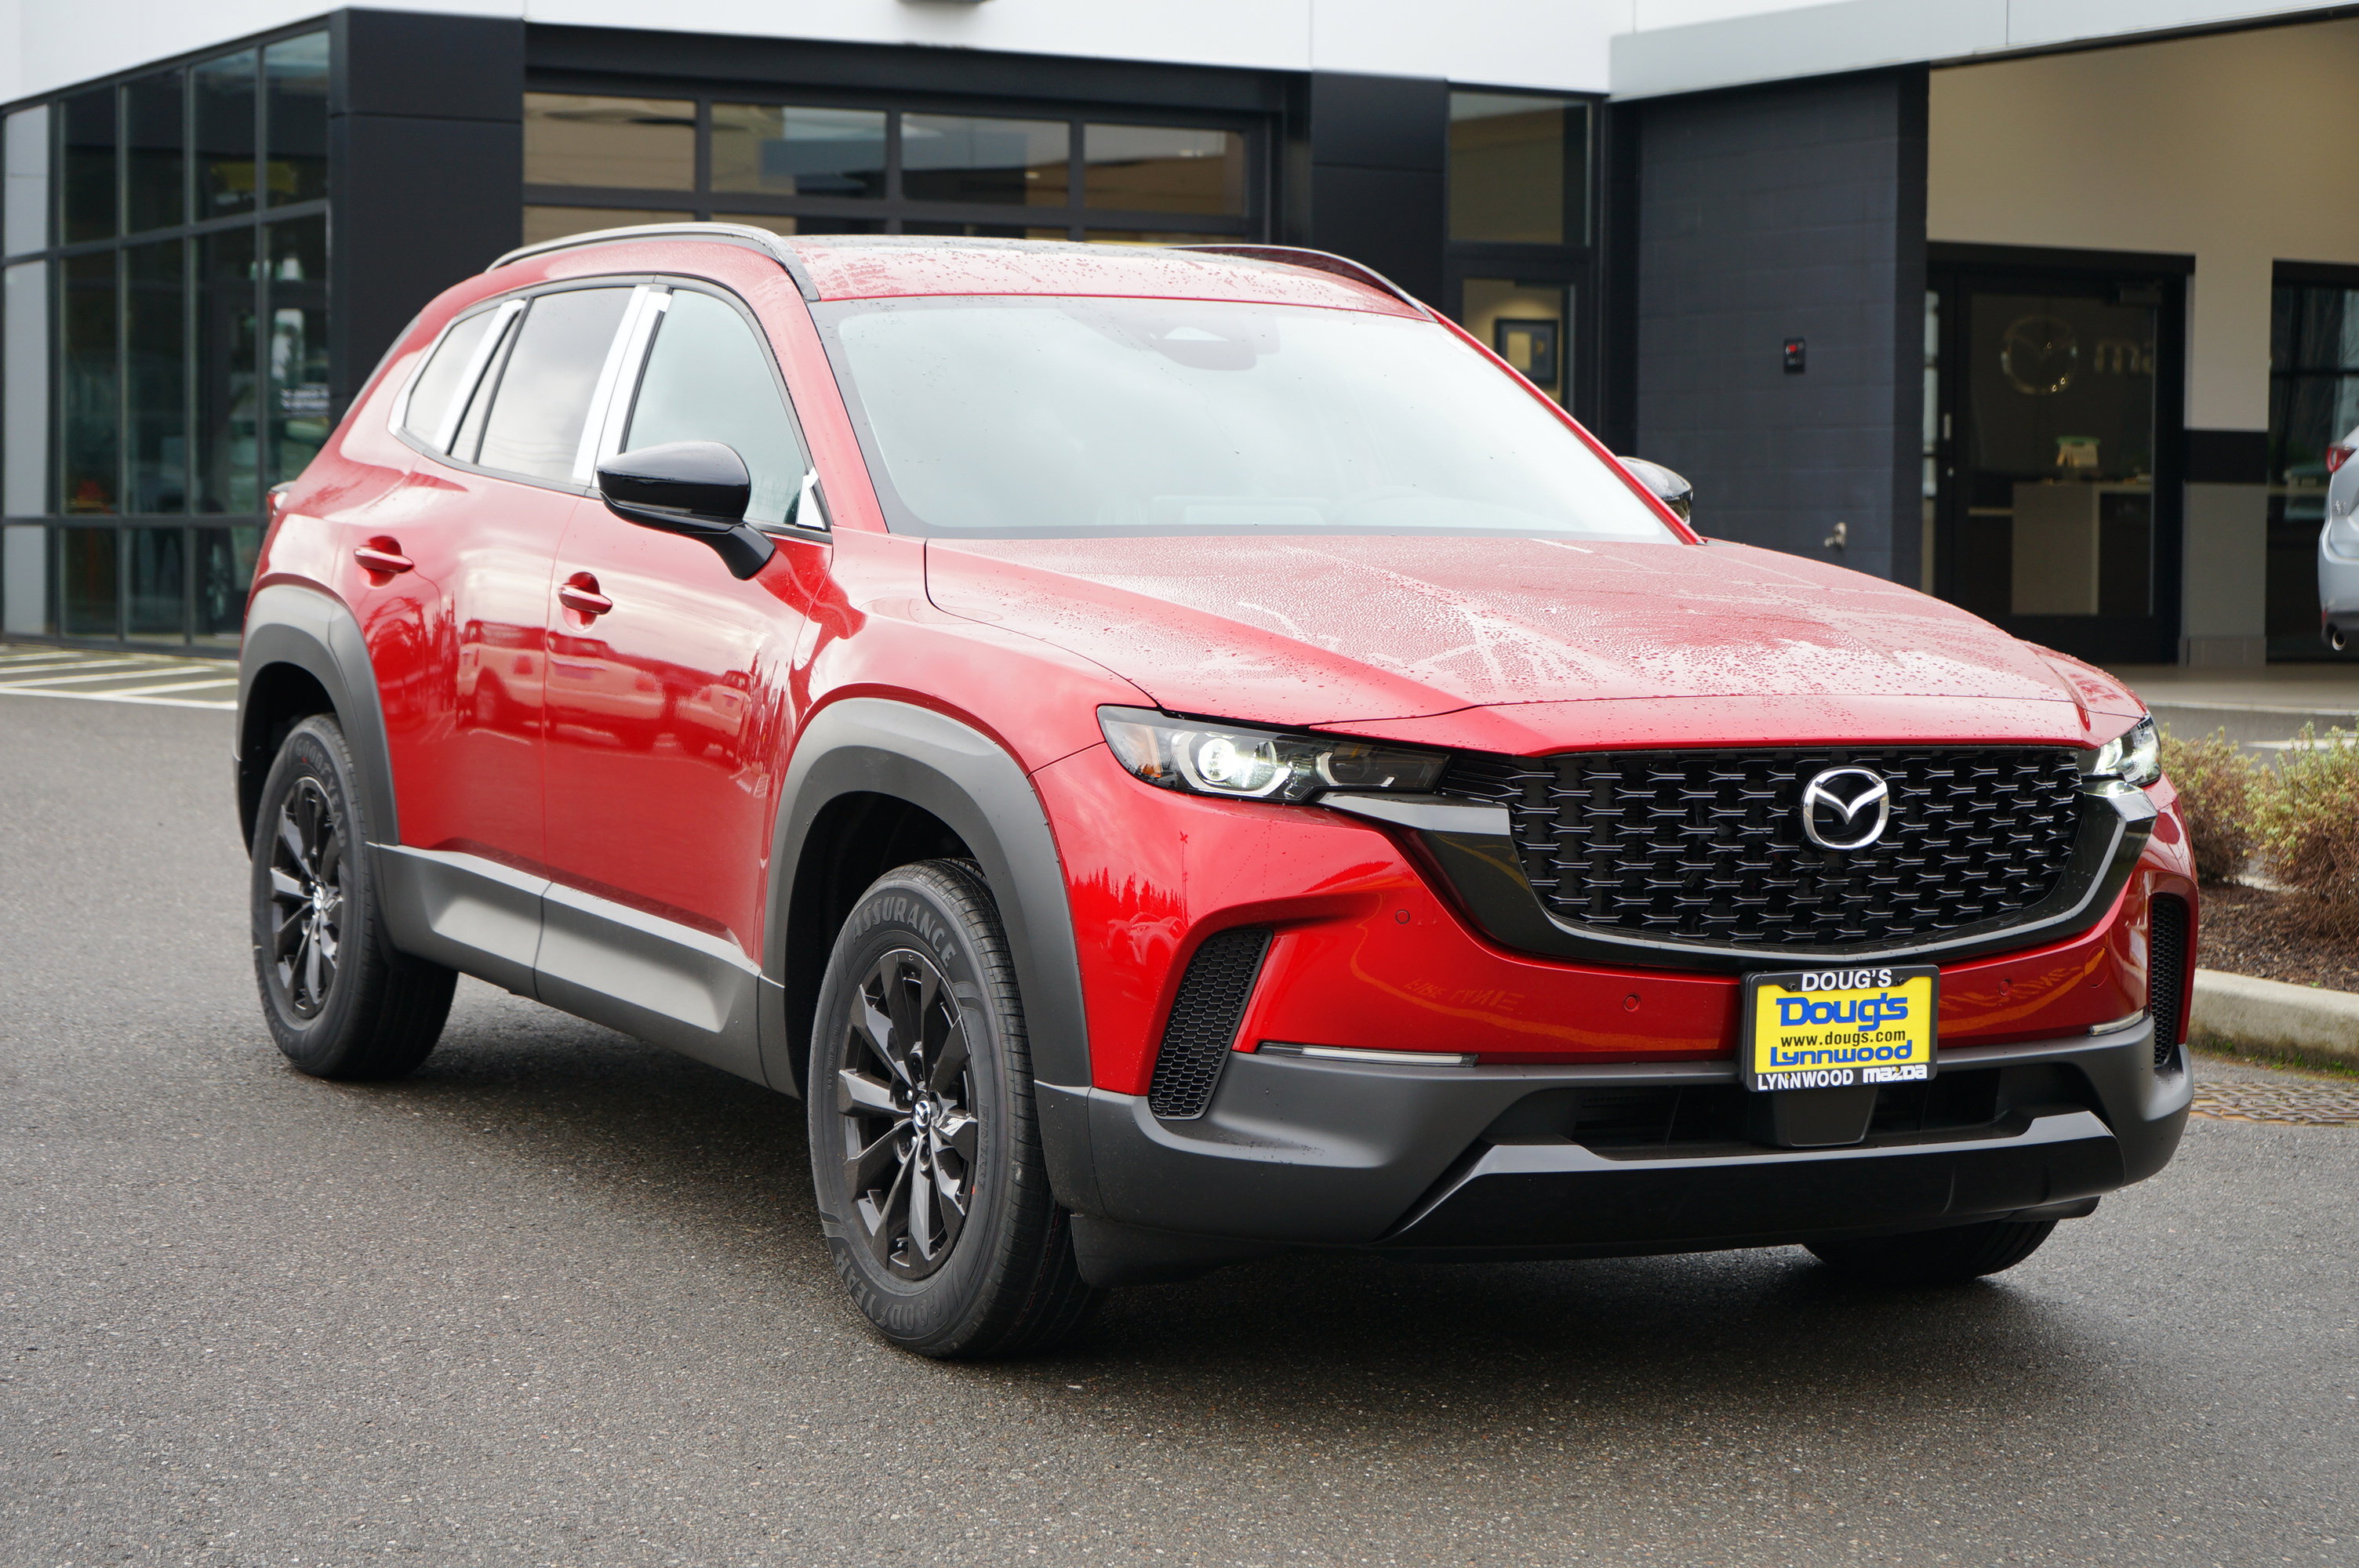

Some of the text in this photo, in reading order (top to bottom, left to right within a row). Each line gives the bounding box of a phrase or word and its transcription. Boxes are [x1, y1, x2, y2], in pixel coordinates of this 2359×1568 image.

[852, 896, 958, 969] ASSURANCE
[1801, 968, 1892, 992] DOUG'S
[1776, 992, 1909, 1032] Doug's
[1780, 1029, 1906, 1047] www.dougs.com
[1770, 1040, 1913, 1066] Lynnwood
[1757, 1068, 1854, 1091] LYNNWOOD
[833, 1247, 941, 1330] GOODYEAR
